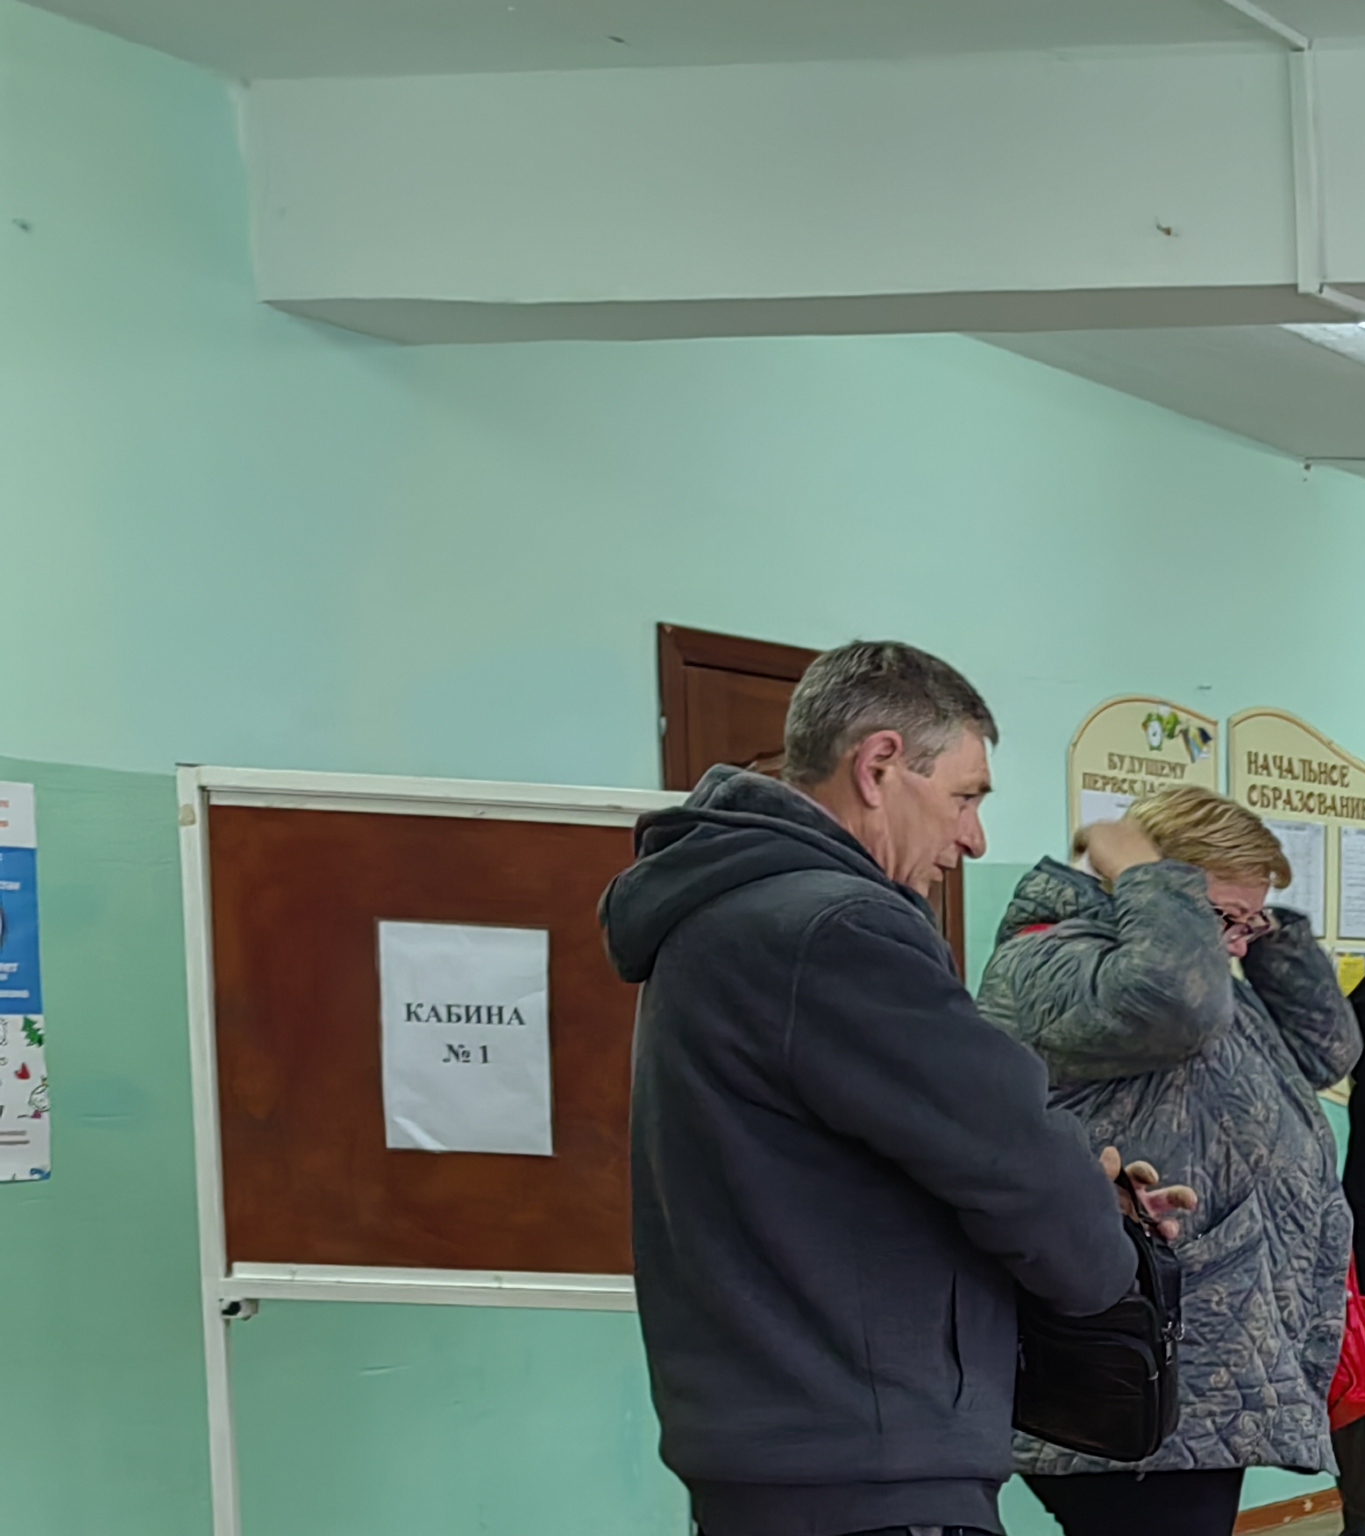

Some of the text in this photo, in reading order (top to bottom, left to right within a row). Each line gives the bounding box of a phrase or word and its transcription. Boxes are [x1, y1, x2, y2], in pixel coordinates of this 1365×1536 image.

[1107, 752, 1187, 779] БУДУЩЕМУ
[1246, 751, 1350, 788] НАЧАЛЬНОЕ
[404, 1002, 526, 1026] КАБИНА
[442, 1043, 490, 1064] № 1
